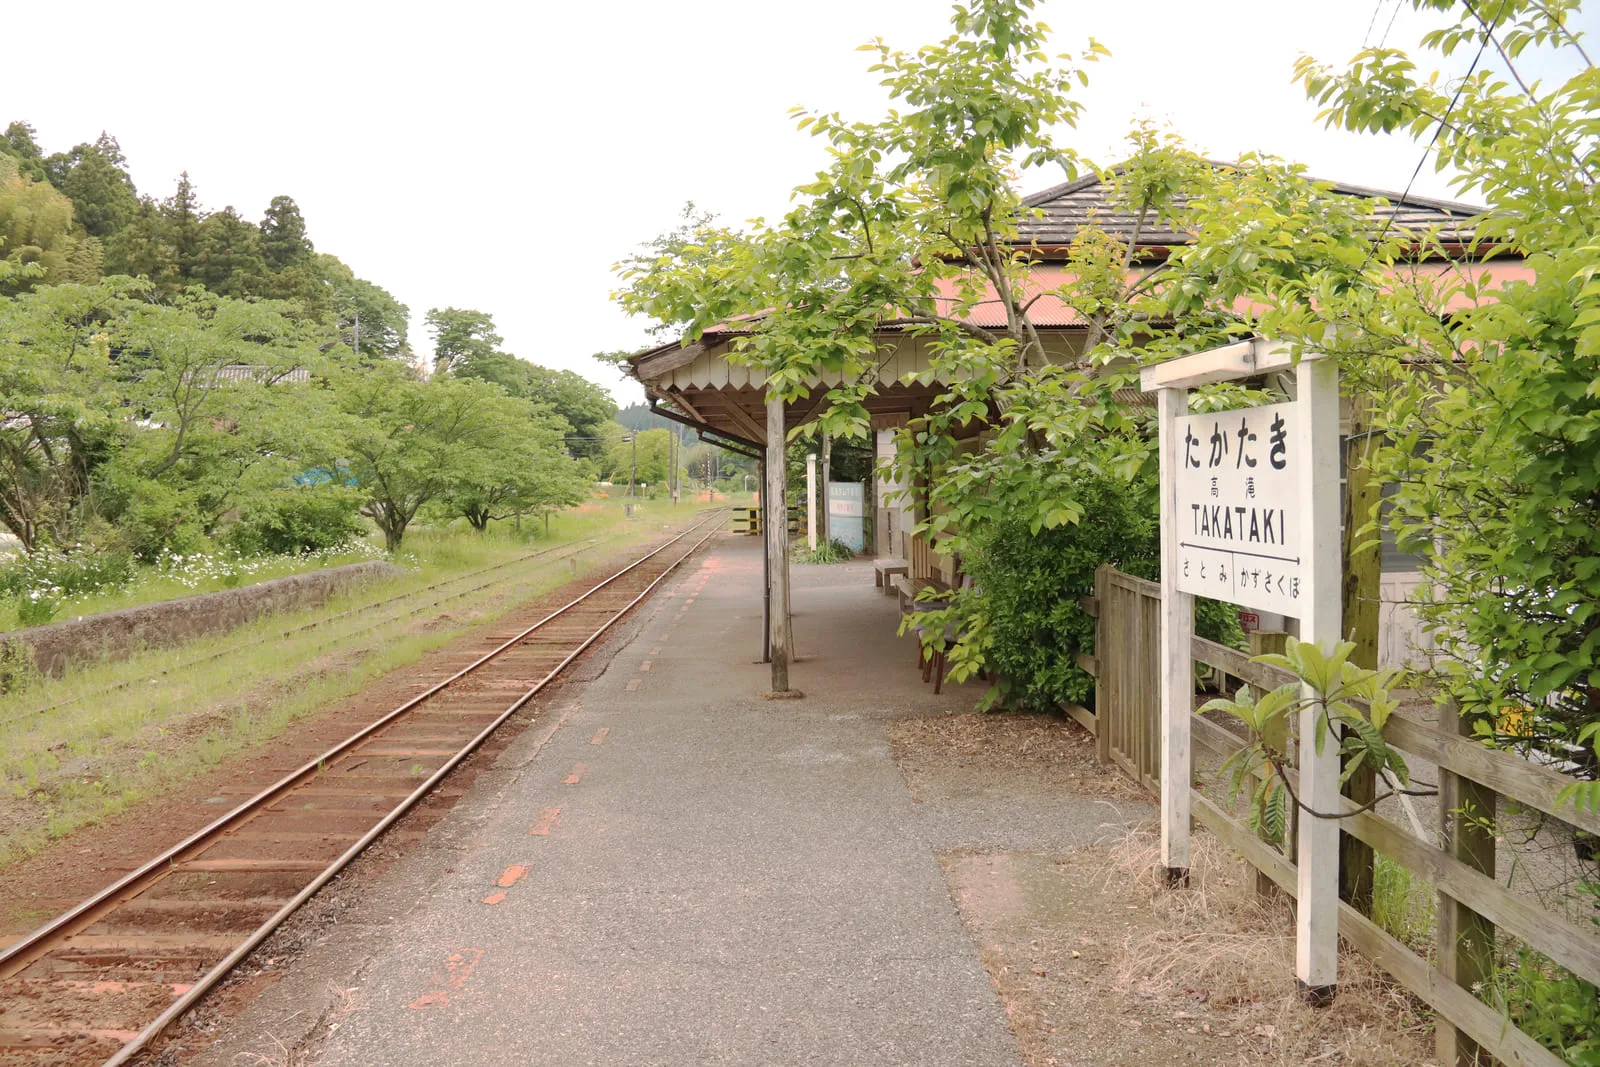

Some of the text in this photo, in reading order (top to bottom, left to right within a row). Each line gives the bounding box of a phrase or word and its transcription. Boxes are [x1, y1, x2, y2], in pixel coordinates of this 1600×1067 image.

[1184, 412, 1287, 470] たかたき
[1210, 476, 1256, 499] 高滝
[1191, 503, 1285, 546] TAKATAKI
[1183, 558, 1301, 600] さとみ かずさくぼ
